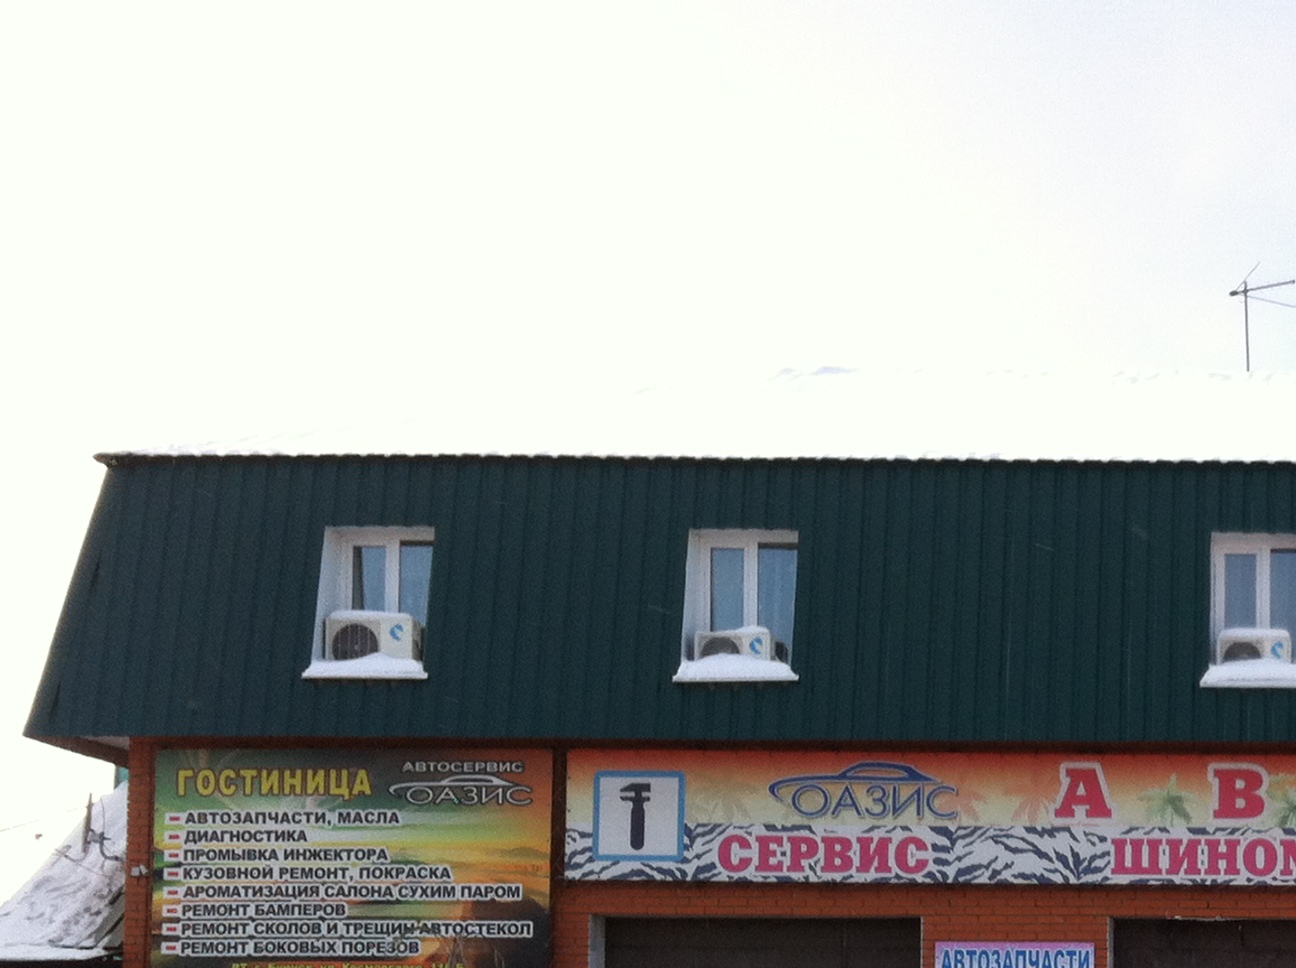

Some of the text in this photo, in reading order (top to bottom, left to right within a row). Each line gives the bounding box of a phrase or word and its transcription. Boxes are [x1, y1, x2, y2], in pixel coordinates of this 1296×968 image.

[402, 761, 524, 773] АВТОСЕРВИС
[176, 768, 373, 801] ГОСТИНИЦА
[404, 783, 533, 806] ОАЗИС
[792, 781, 960, 819] ОАЗИС
[185, 811, 399, 826] АВТОЗАПЧАСТИ, МАСЛА
[184, 830, 308, 844] ДИАГНОСТИКА
[183, 848, 388, 862] ПРОМЫВКА ИНЖЕКТОРА
[717, 834, 930, 876] СЕРВИС
[183, 864, 452, 881] КУЗОВНОЙ РЕМОНТ, ПОКРАСКА
[183, 885, 521, 900] АРОМАТИЗАЦИЯ САЛОНА СУХИМ ПАРОМ
[181, 903, 346, 917] РЕМОНТ БАМПЕРОВ
[181, 922, 531, 937] РЕМОНТ СКОЛОВ И ТРЕЩИН АВТОСТЕКОЛ
[180, 941, 420, 954] РЕМОНТ БОКОВЫХ ПОРЕЗОВ
